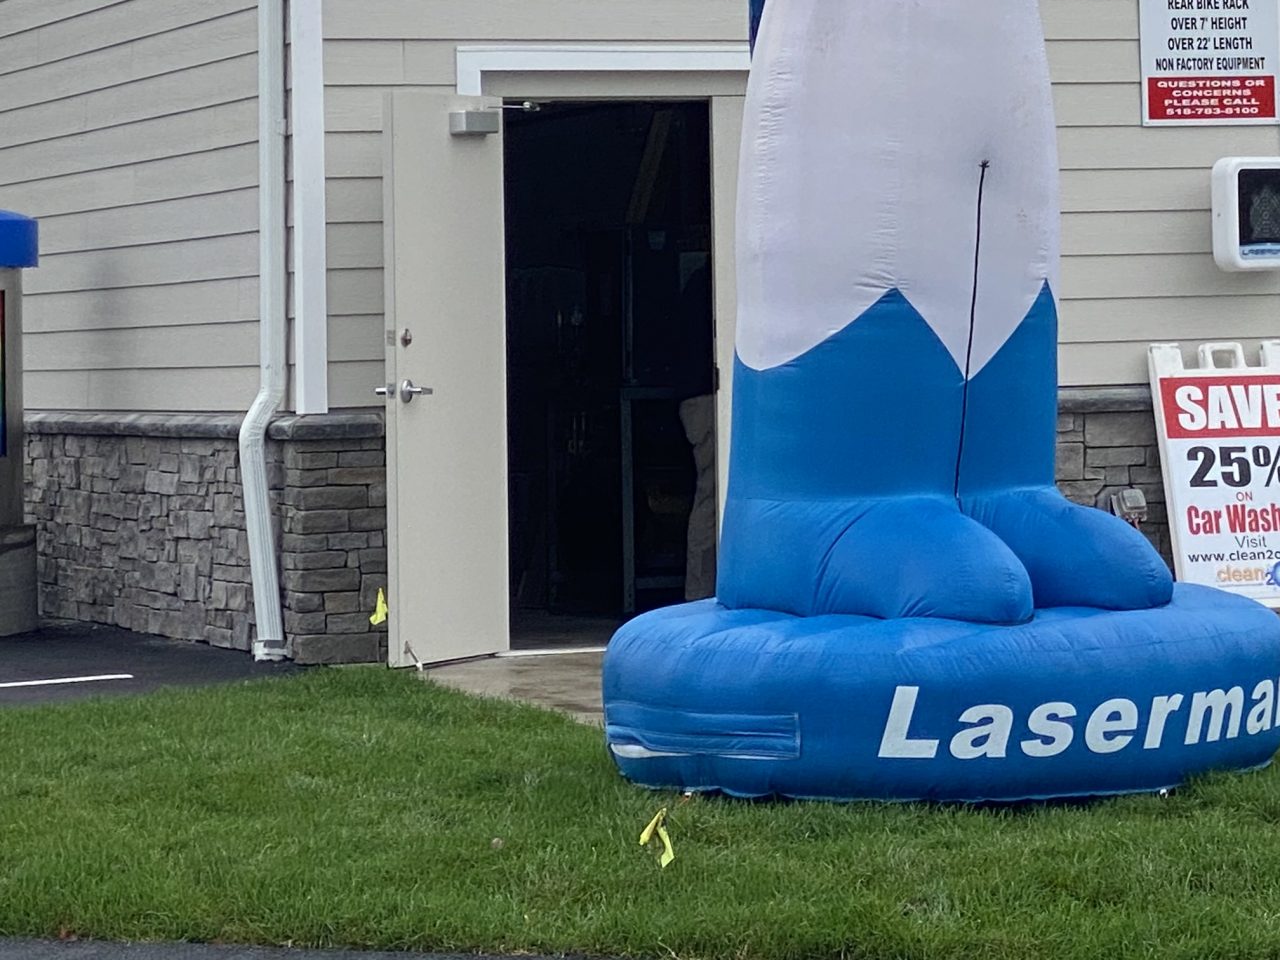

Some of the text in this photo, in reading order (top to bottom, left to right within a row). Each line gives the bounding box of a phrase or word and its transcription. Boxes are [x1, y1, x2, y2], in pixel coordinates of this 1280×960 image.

[1171, 17, 1198, 30] OVER
[1210, 17, 1247, 30] HEIGHT
[1168, 38, 1194, 51] OVER
[1213, 37, 1252, 50] LENGTH
[1155, 57, 1265, 71] NON FACTORY EQUIPMENT
[1157, 79, 1265, 88] QUESTIONS OR
[1172, 89, 1251, 97] CONCERNS
[1164, 98, 1260, 107] PLEASE CALL
[1236, 492, 1253, 502] ON
[1187, 505, 1222, 535] Car
[1235, 535, 1267, 548] Visit
